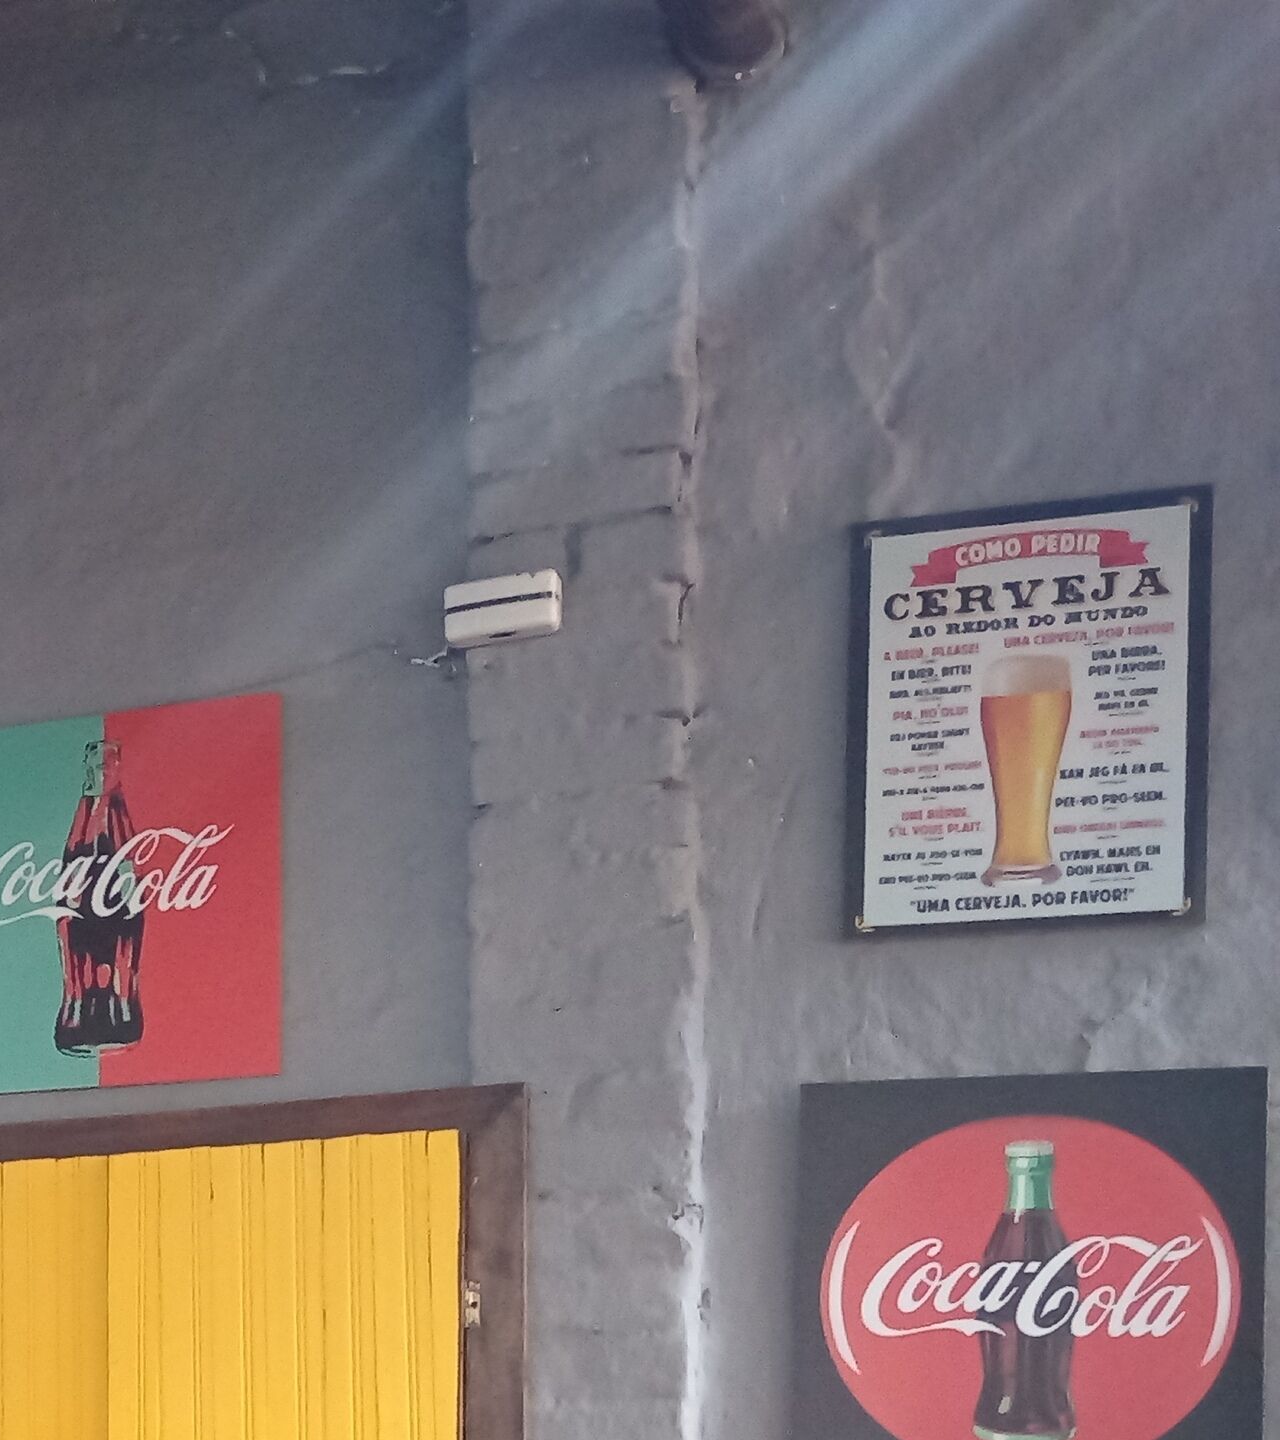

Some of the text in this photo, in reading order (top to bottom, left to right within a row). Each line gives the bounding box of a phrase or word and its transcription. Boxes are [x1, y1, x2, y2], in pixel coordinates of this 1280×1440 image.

[955, 533, 1101, 567] COMO PEDIR
[883, 567, 1171, 621] CERVEJA
[909, 625, 936, 639] AO
[1028, 614, 1056, 628] DO
[1064, 605, 1149, 624] MUNDO
[1032, 890, 1067, 907] POR
[861, 1235, 1204, 1338] Coca-Cola
